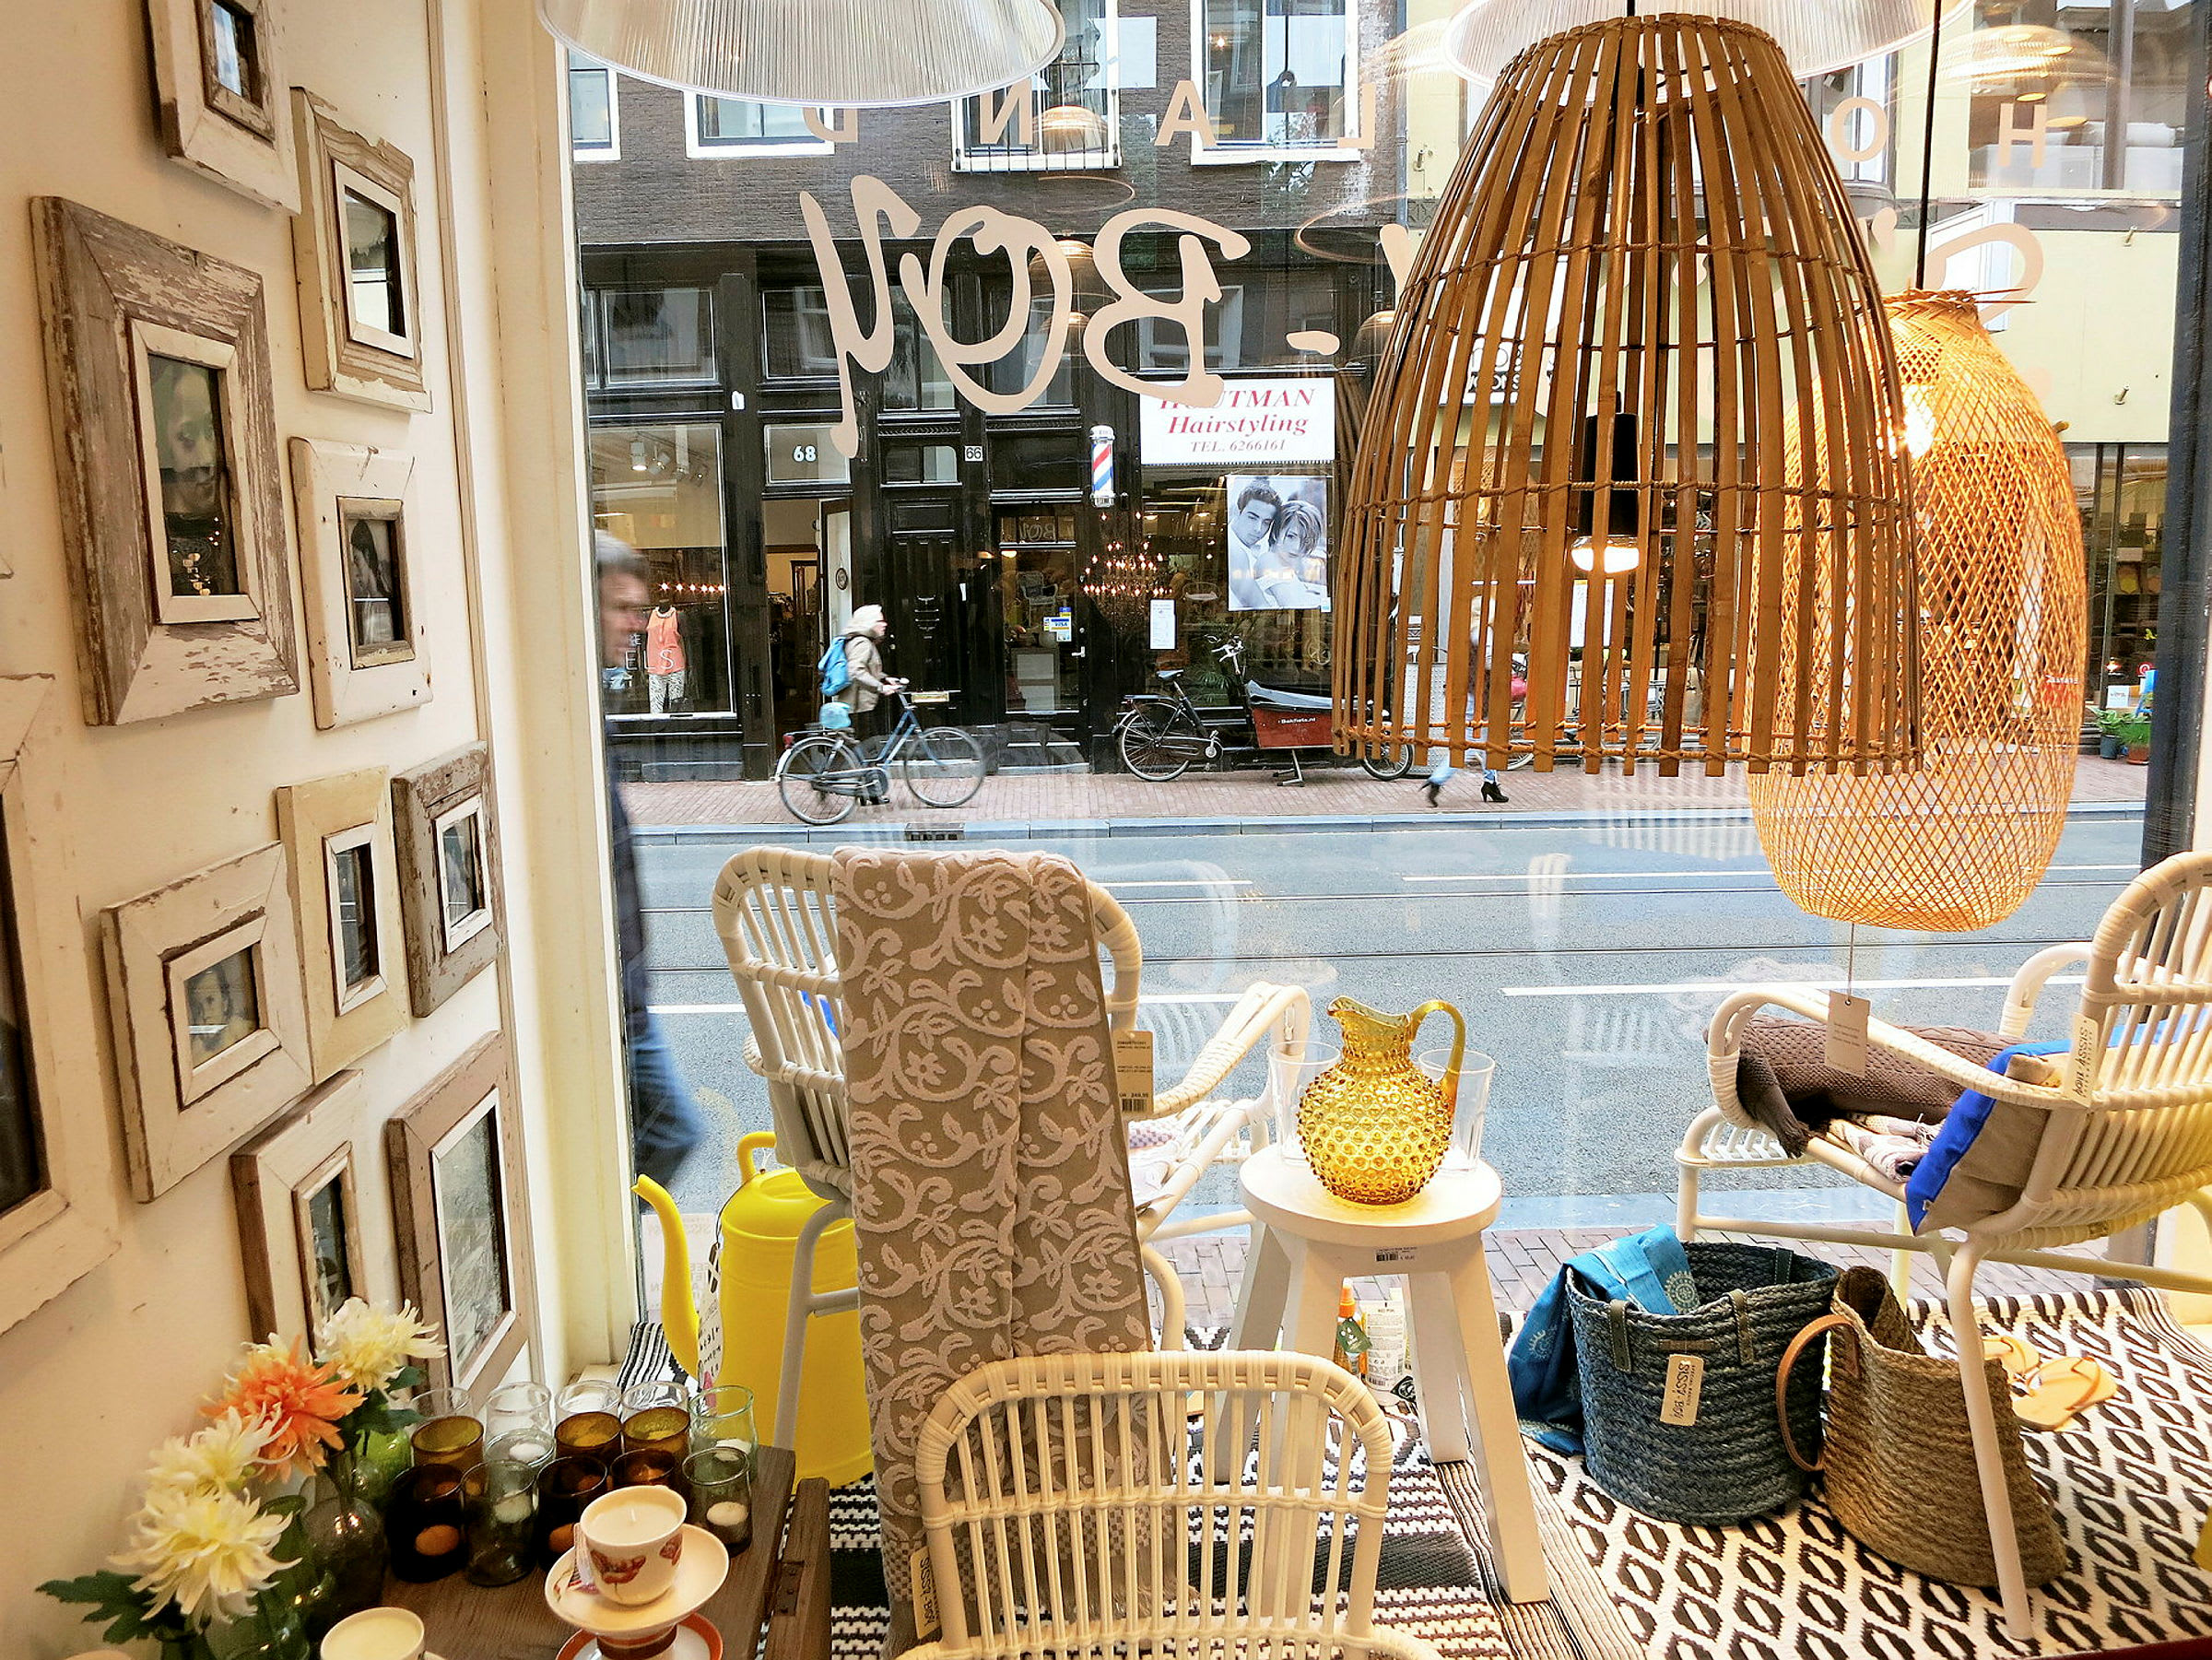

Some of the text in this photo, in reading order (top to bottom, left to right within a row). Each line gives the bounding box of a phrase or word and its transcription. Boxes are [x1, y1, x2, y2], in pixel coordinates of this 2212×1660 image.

[1159, 388, 1315, 409] TMAN
[1168, 415, 1309, 436] Hairstyling
[793, 445, 818, 462] 68
[966, 447, 982, 459] 66
[1191, 439, 1287, 453] TEL. 6266161
